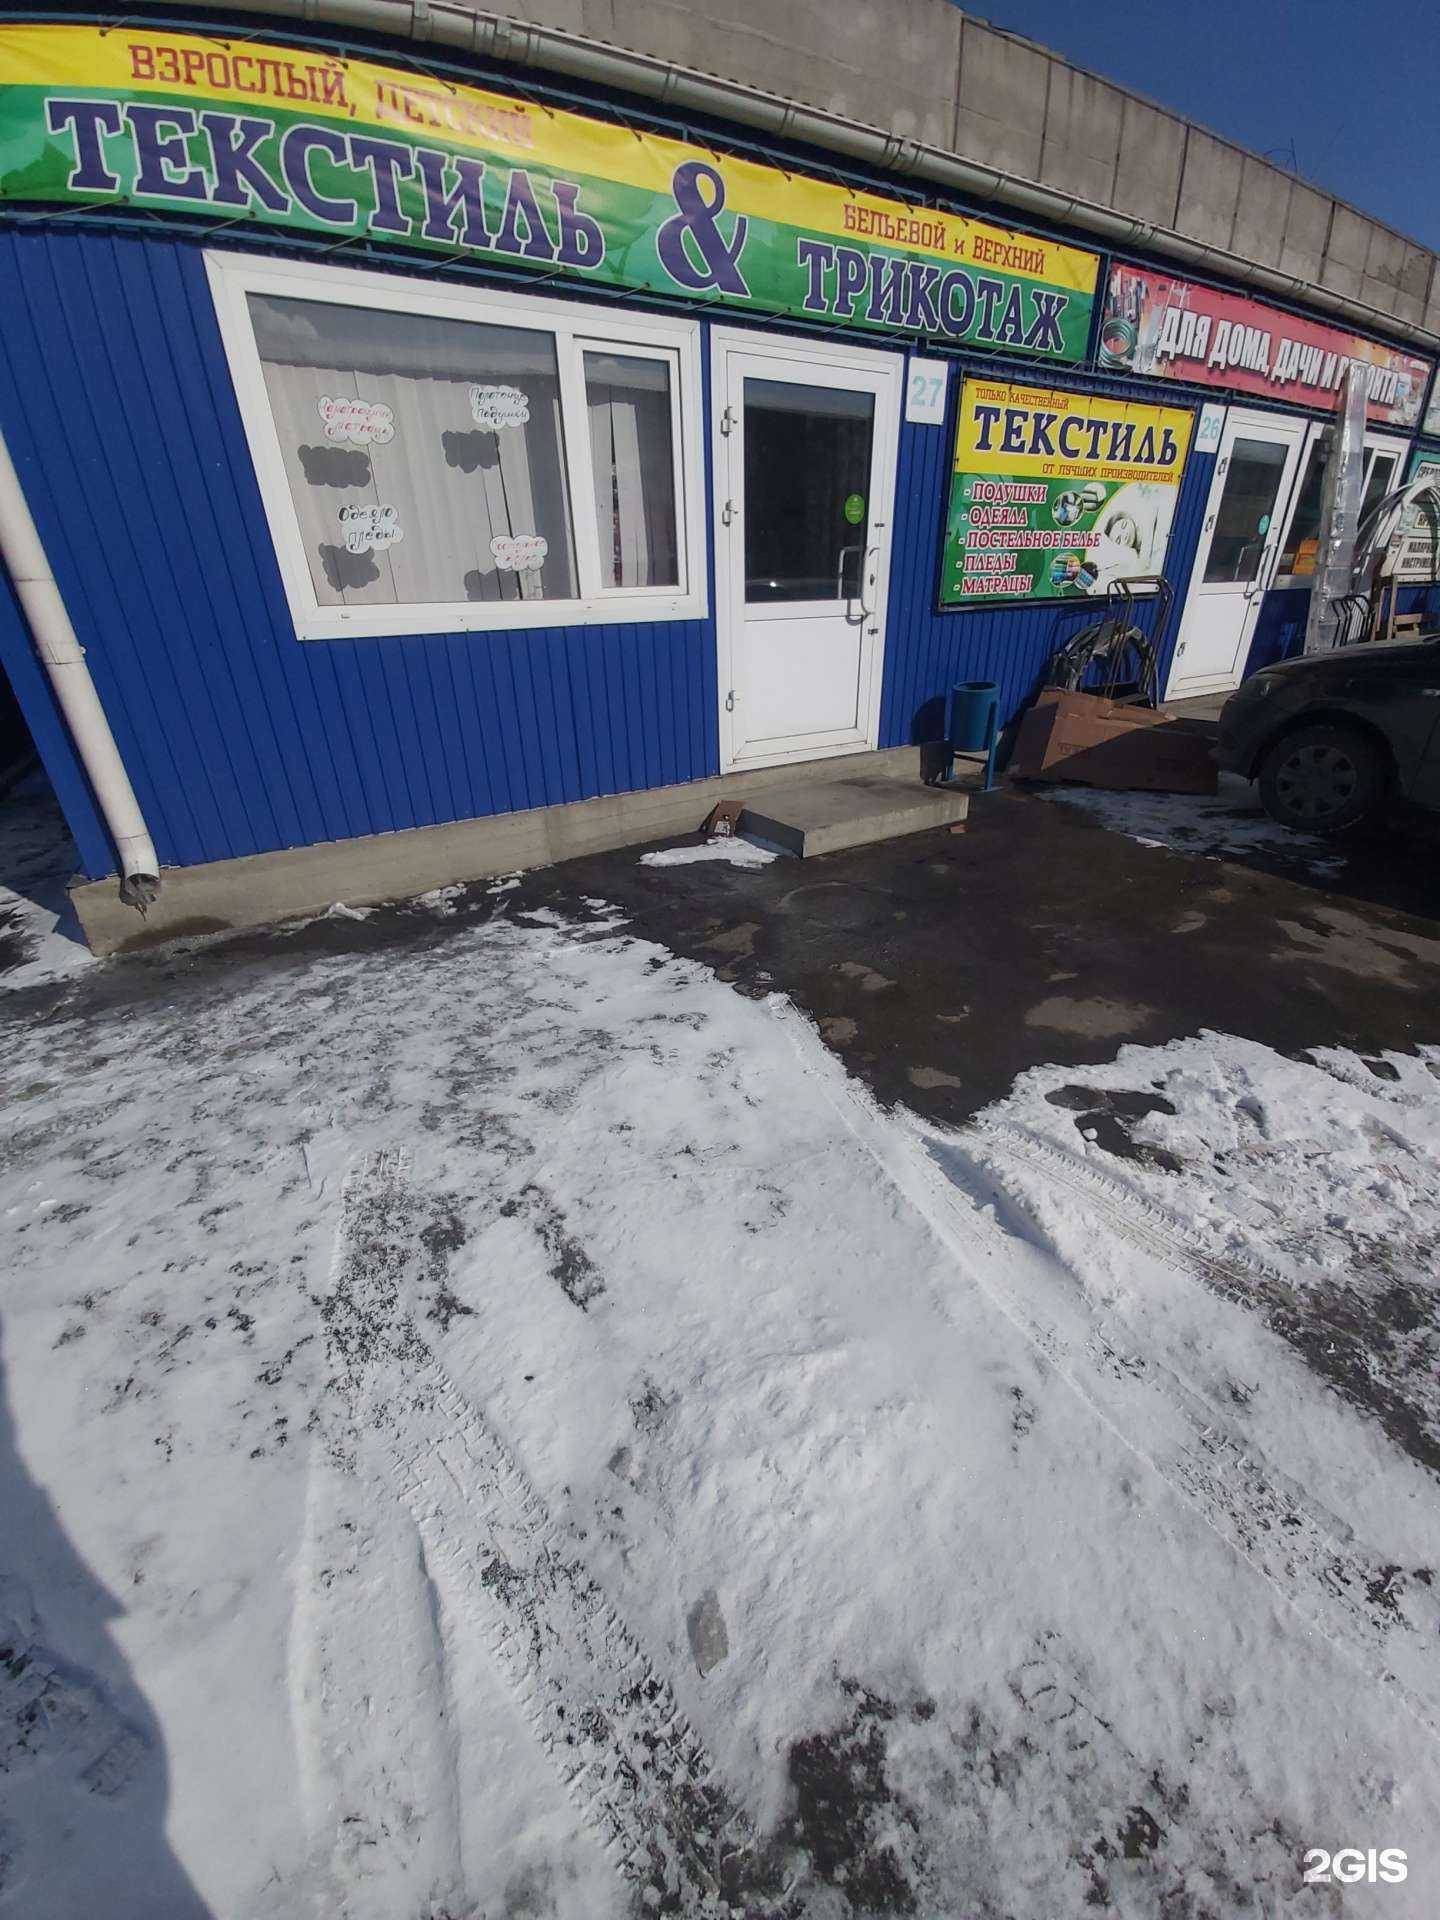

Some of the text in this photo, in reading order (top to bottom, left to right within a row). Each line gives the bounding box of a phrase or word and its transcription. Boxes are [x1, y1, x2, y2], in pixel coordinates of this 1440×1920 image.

[128, 44, 357, 117] ВЗРОСЛЫЙ,
[45, 98, 605, 270] ТЕКСТИЛЬ
[656, 160, 752, 299] &
[843, 204, 946, 251] БЕЛЬЕВОЙ
[972, 236, 1045, 275] ВЕРХНИЙ
[797, 237, 1069, 354] ТРИКОТАЖ
[1157, 305, 1212, 361] ДЛЯ
[1207, 319, 1271, 378] ДОМА,
[1271, 337, 1325, 384] ДАЧИ
[911, 375, 943, 408] 27
[975, 387, 1007, 402] ТОЛЬКО
[974, 405, 1178, 466] ТЕКСТИЛЬ
[1200, 416, 1220, 440] 26
[1042, 463, 1055, 475] ОТ
[1058, 465, 1098, 478] ЛУЧШИХ
[971, 482, 1048, 504] ПОДУШКИ
[969, 506, 1029, 526] ОДЕЯЛА
[966, 531, 1102, 549] ПОСТЕЛЬНОЕ БЕЛЬЕ
[963, 553, 1017, 573] ПЛЕДЫ
[960, 575, 1033, 595] МАТРАЦЫ
